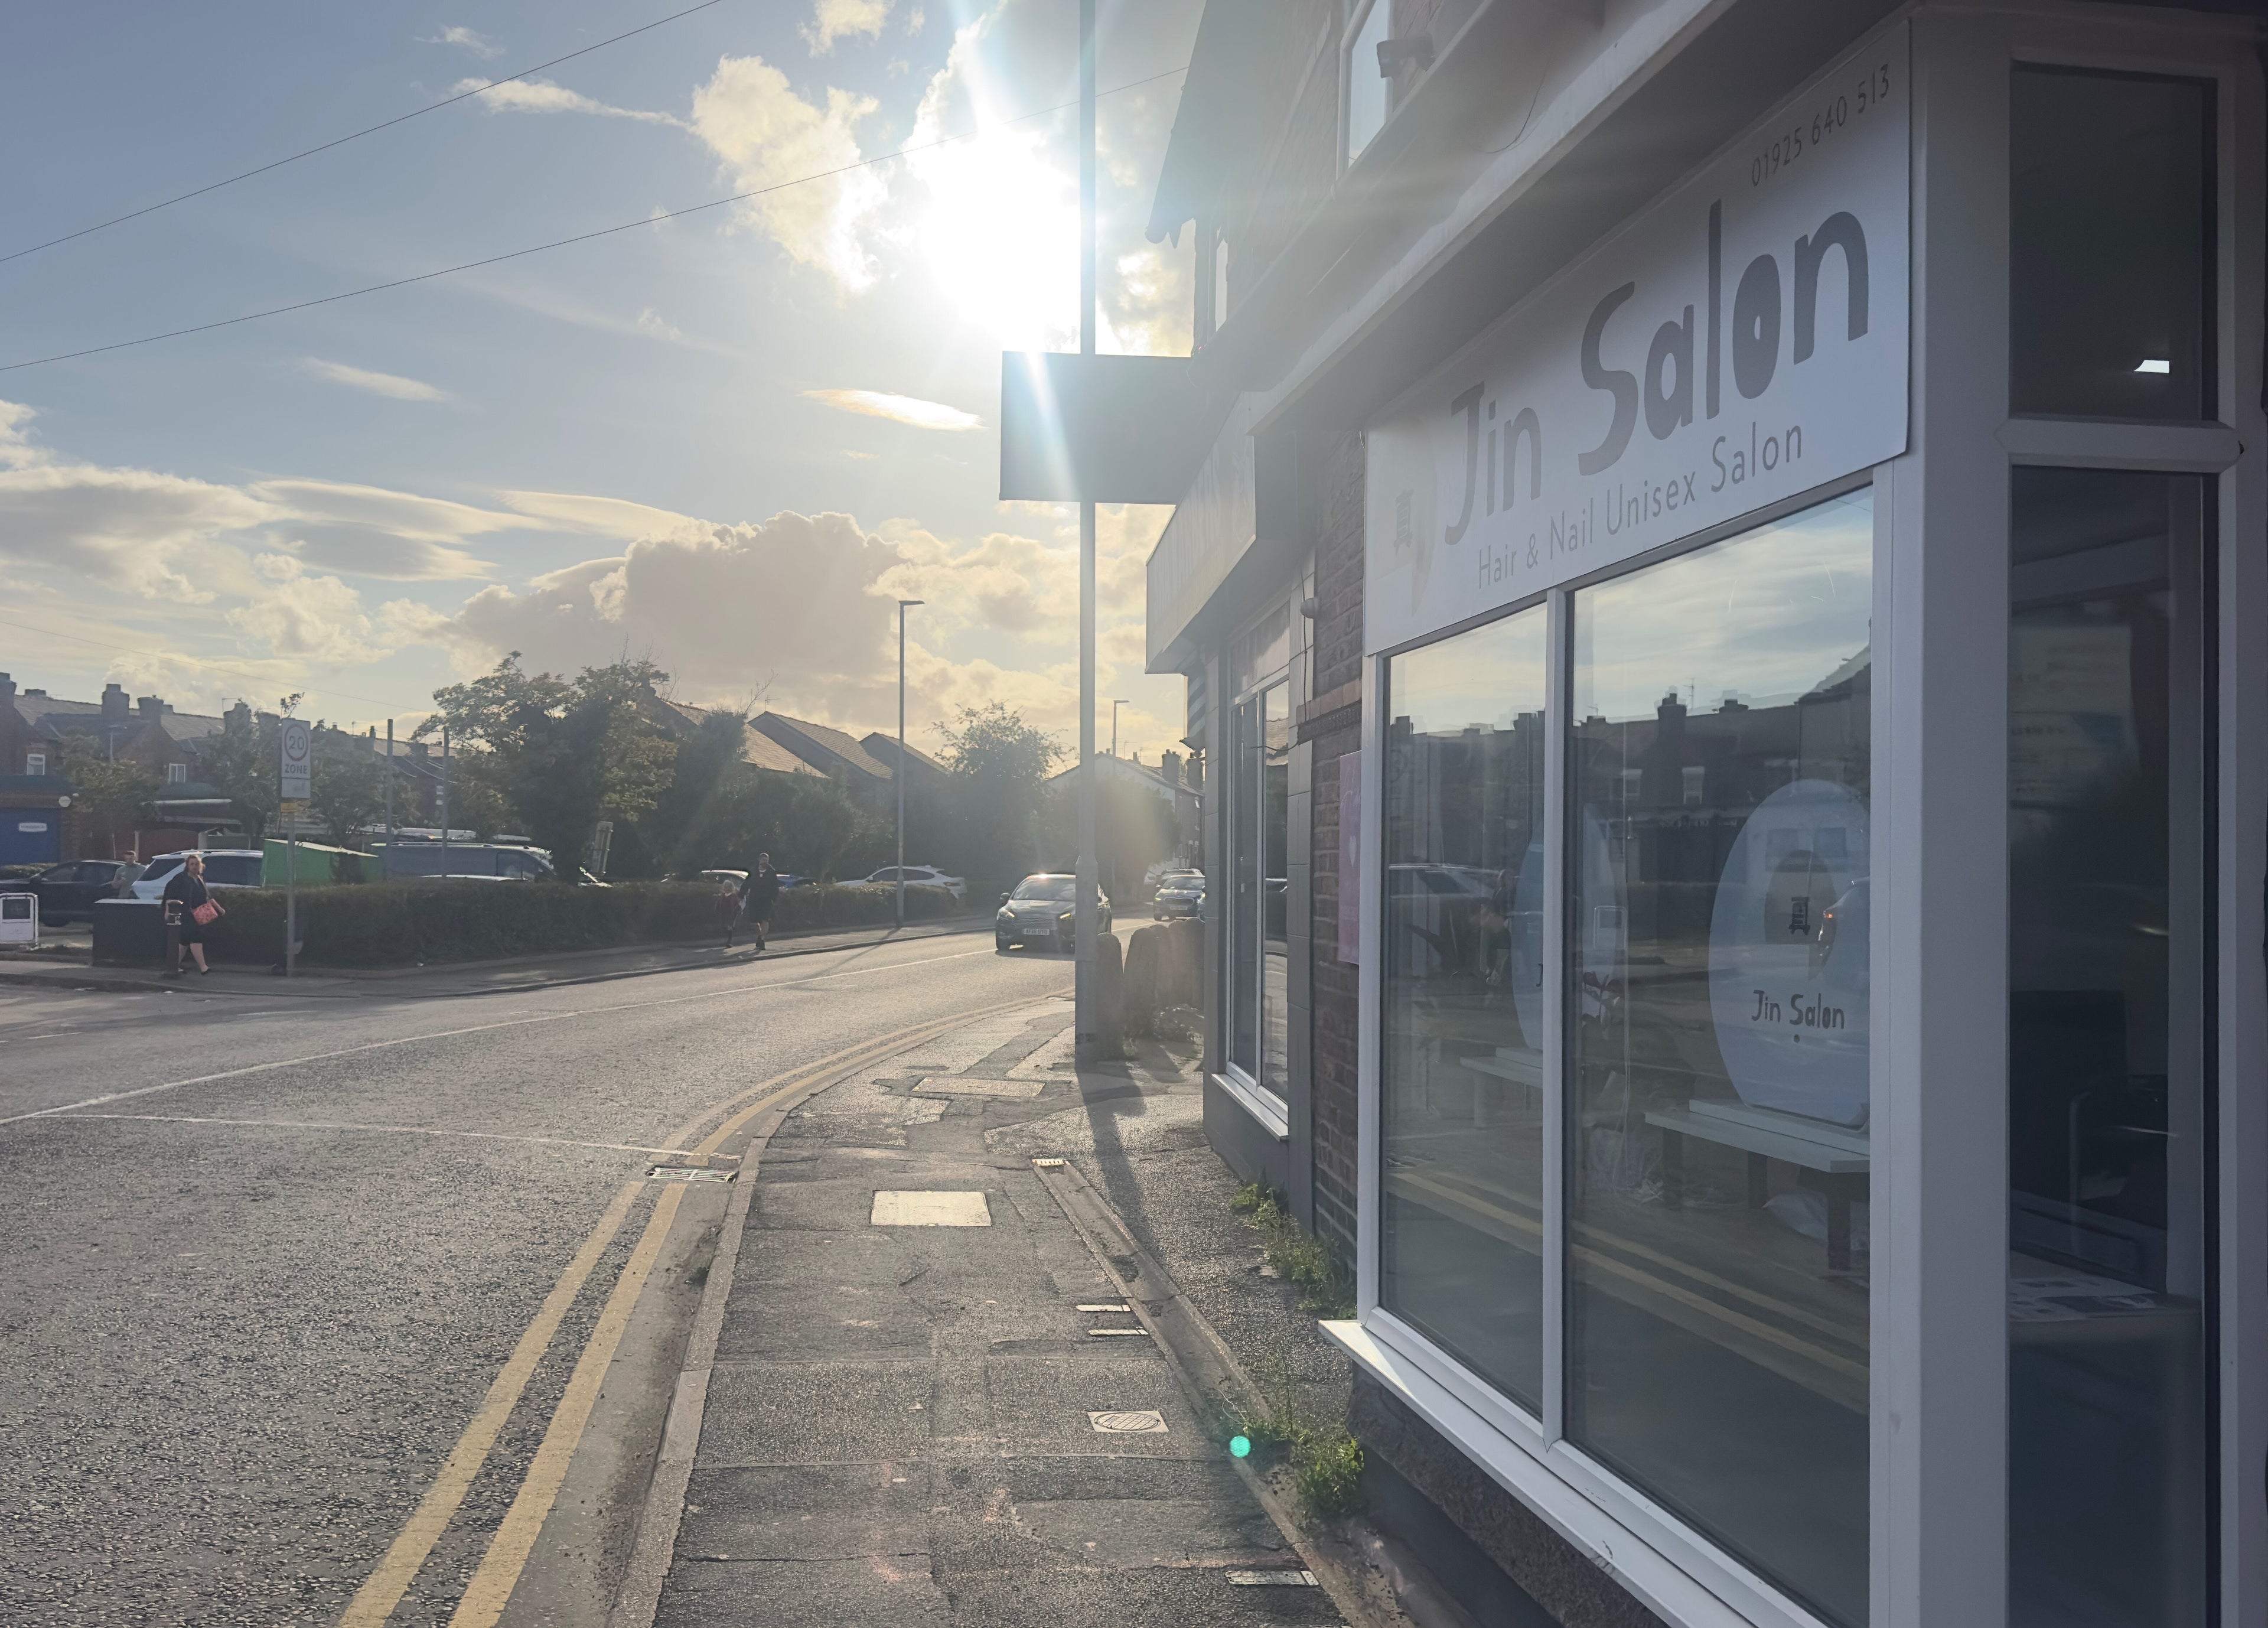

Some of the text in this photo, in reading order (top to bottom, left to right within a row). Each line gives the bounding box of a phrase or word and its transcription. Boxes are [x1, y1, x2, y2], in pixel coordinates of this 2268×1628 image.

[1752, 63, 1889, 186] 01925 640 513
[1445, 380, 1542, 545] Jin
[1578, 198, 1869, 476] Salon
[1478, 421, 1801, 590] Hair & Nail Unisex Salon
[285, 764, 308, 774] ZONE
[289, 736, 305, 750] 20
[1751, 989, 1845, 1030] Jin Salon
